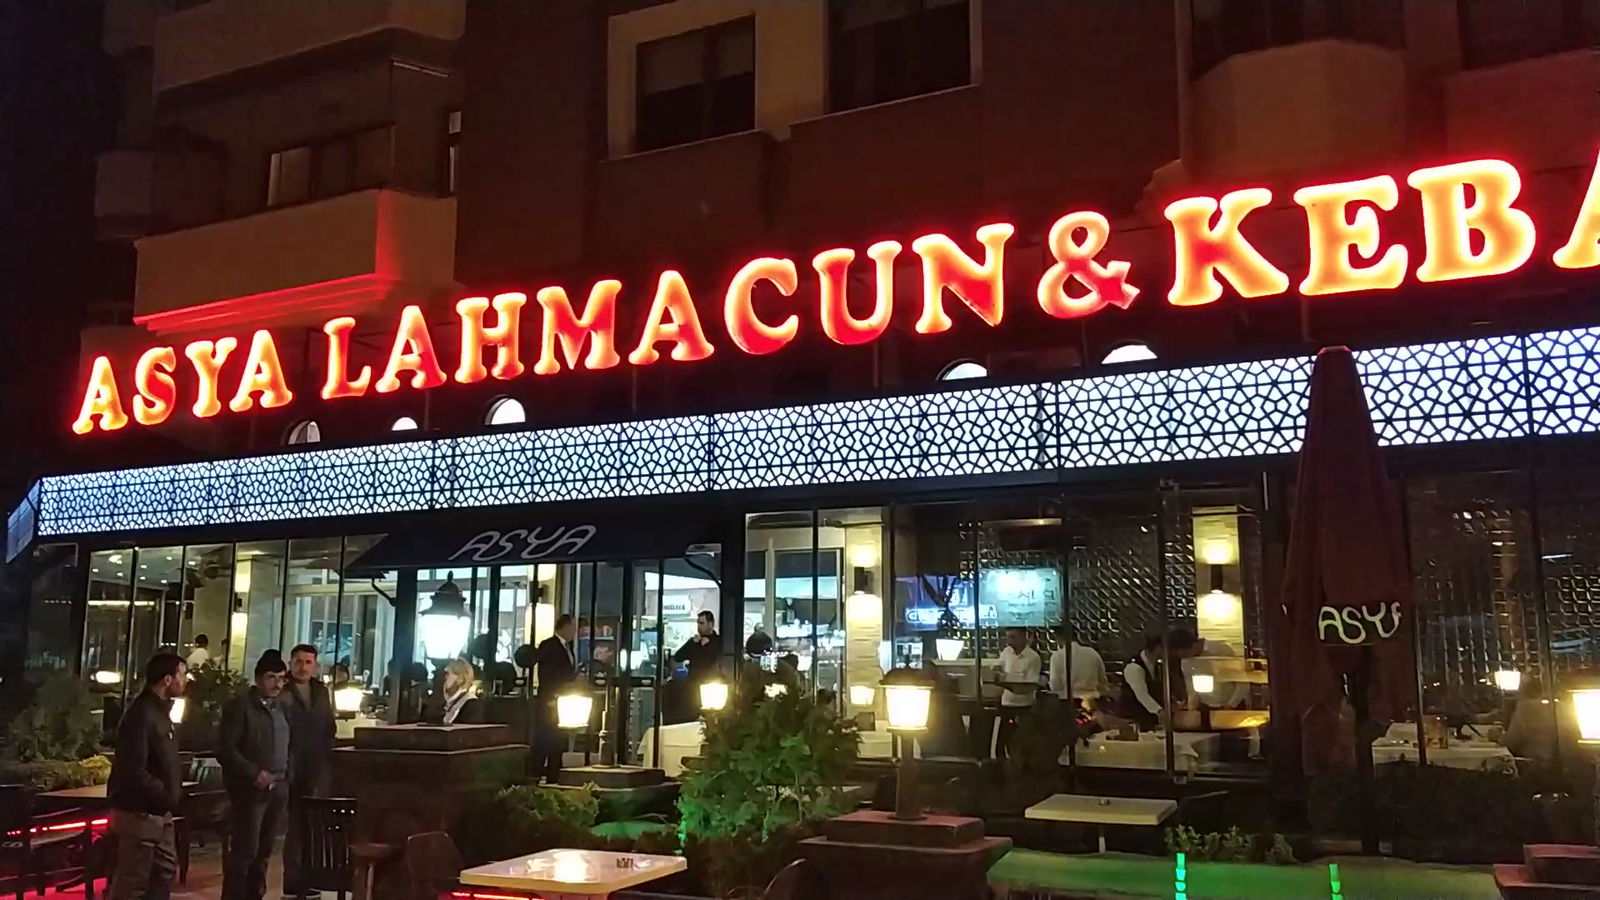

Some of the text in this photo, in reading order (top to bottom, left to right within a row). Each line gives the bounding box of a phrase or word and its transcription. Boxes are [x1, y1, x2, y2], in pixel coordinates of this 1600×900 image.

[72, 328, 294, 435] ASYA
[320, 222, 1015, 400] LAHMACUN
[448, 524, 597, 561] ASYA
